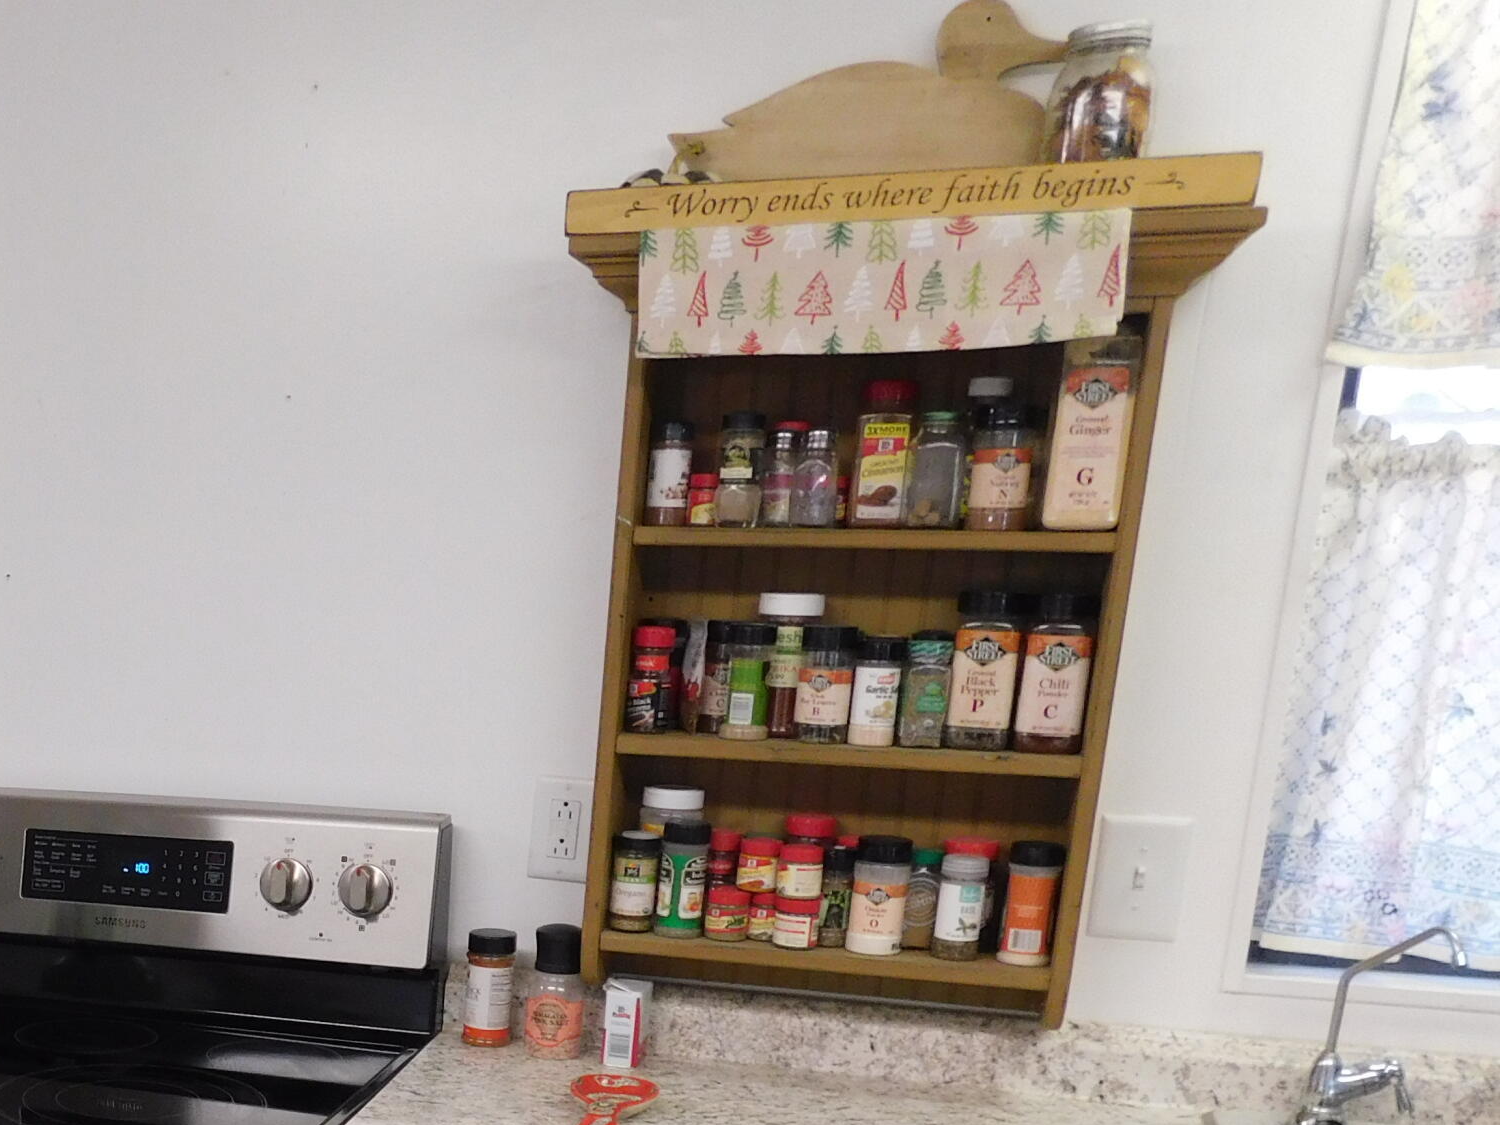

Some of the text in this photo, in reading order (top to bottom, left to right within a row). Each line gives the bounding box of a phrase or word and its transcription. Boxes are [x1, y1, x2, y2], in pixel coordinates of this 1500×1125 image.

[667, 169, 1135, 223] Worry ends where faith begins
[1069, 424, 1112, 436] Ginger
[1076, 467, 1094, 486] G
[966, 676, 995, 687] Black
[1039, 679, 1069, 690] Chili
[960, 685, 999, 697] Pepper
[972, 699, 984, 712] P
[1043, 704, 1058, 719] C
[95, 916, 146, 929] SAMSUNG
